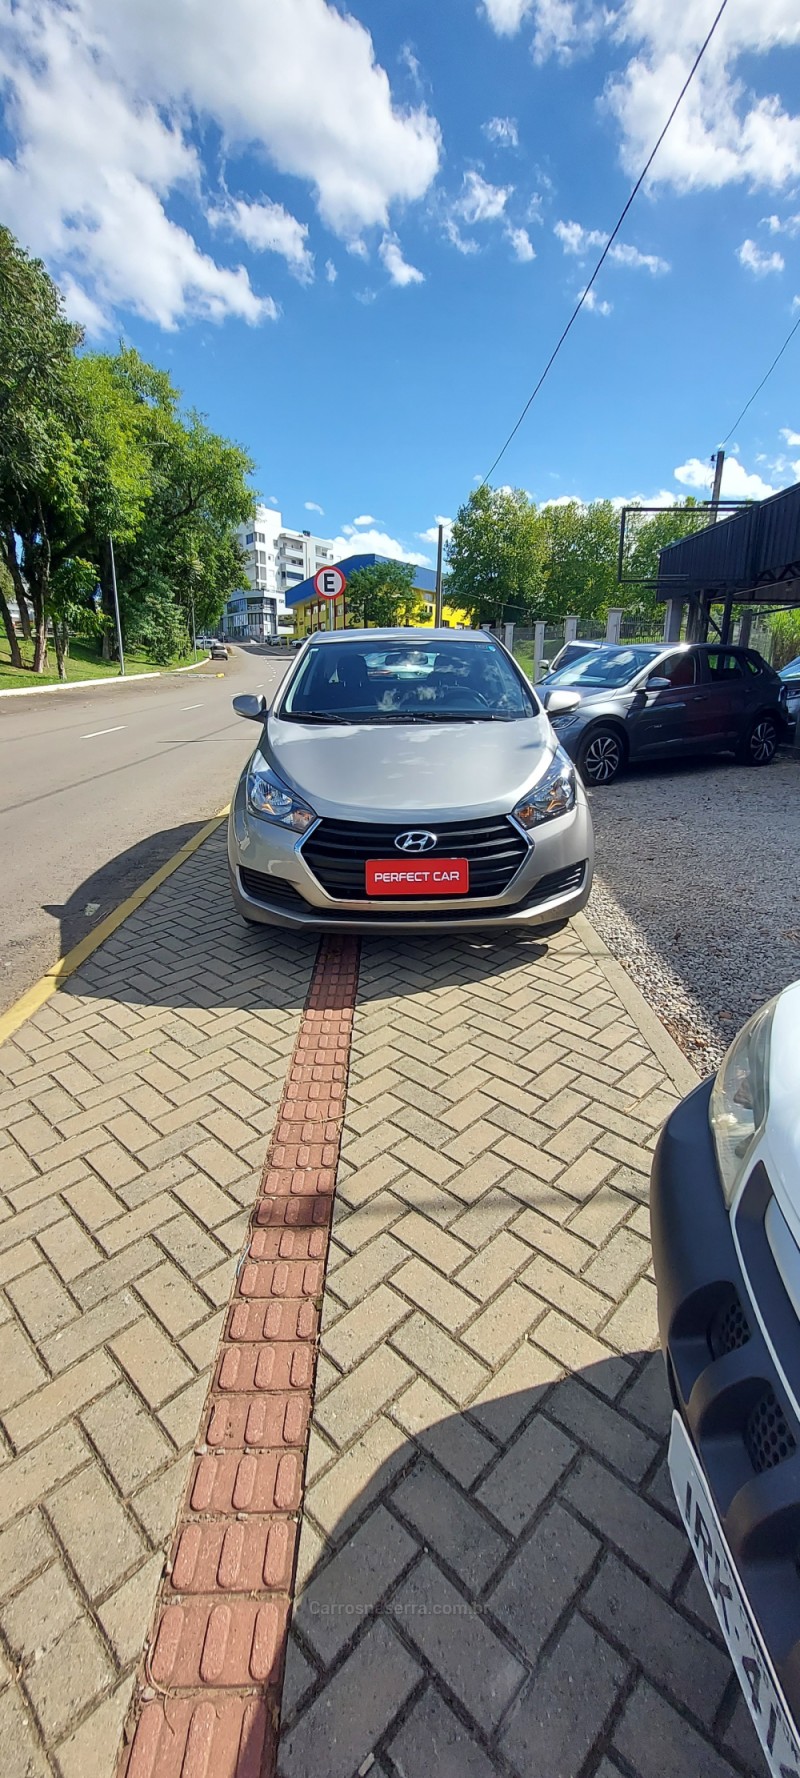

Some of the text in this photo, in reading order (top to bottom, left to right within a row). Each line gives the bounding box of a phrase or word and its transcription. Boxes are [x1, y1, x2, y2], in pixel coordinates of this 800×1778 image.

[324, 573, 335, 592] E
[374, 871, 460, 883] PERFECT CAR
